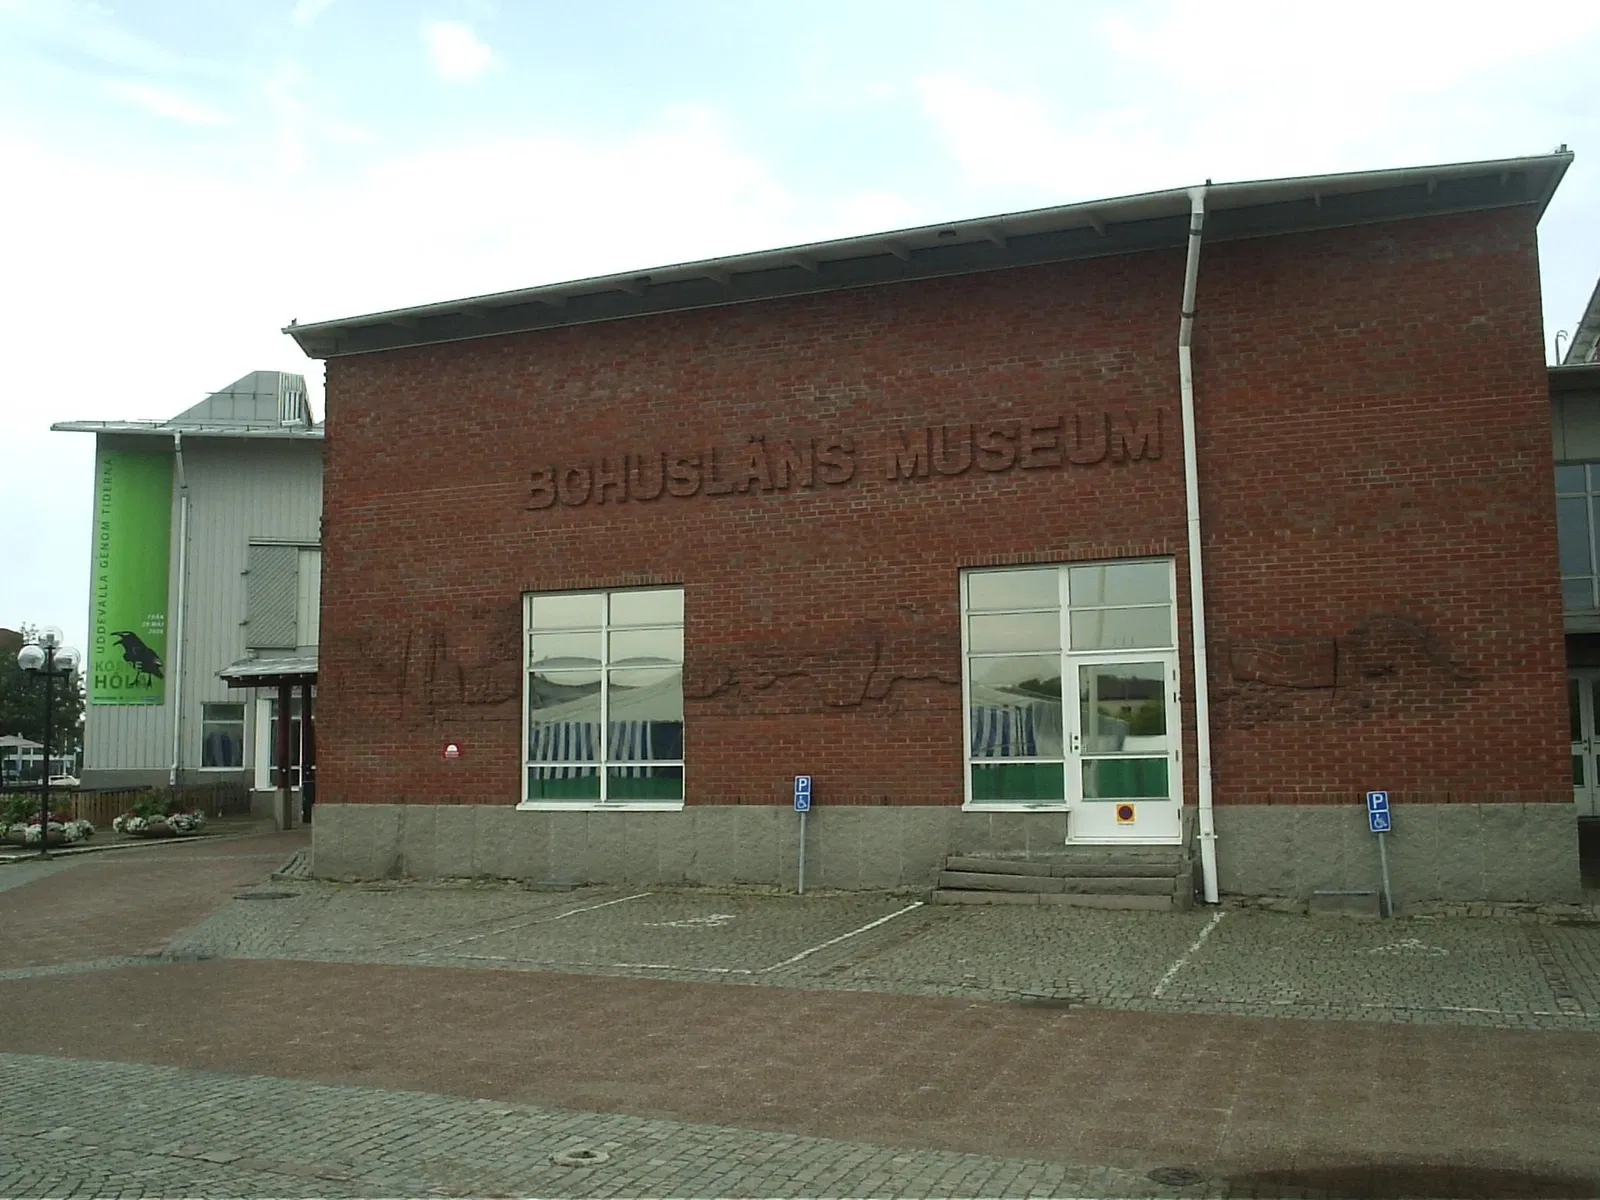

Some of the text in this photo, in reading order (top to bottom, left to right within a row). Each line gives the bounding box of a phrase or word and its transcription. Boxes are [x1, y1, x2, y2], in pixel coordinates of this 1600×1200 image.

[525, 407, 1164, 511] BOHUSLÄNS MUSEUM
[96, 459, 113, 654] UDDEVALLA GENOM TIDERNA
[799, 778, 807, 791] P
[1373, 794, 1383, 809] P
